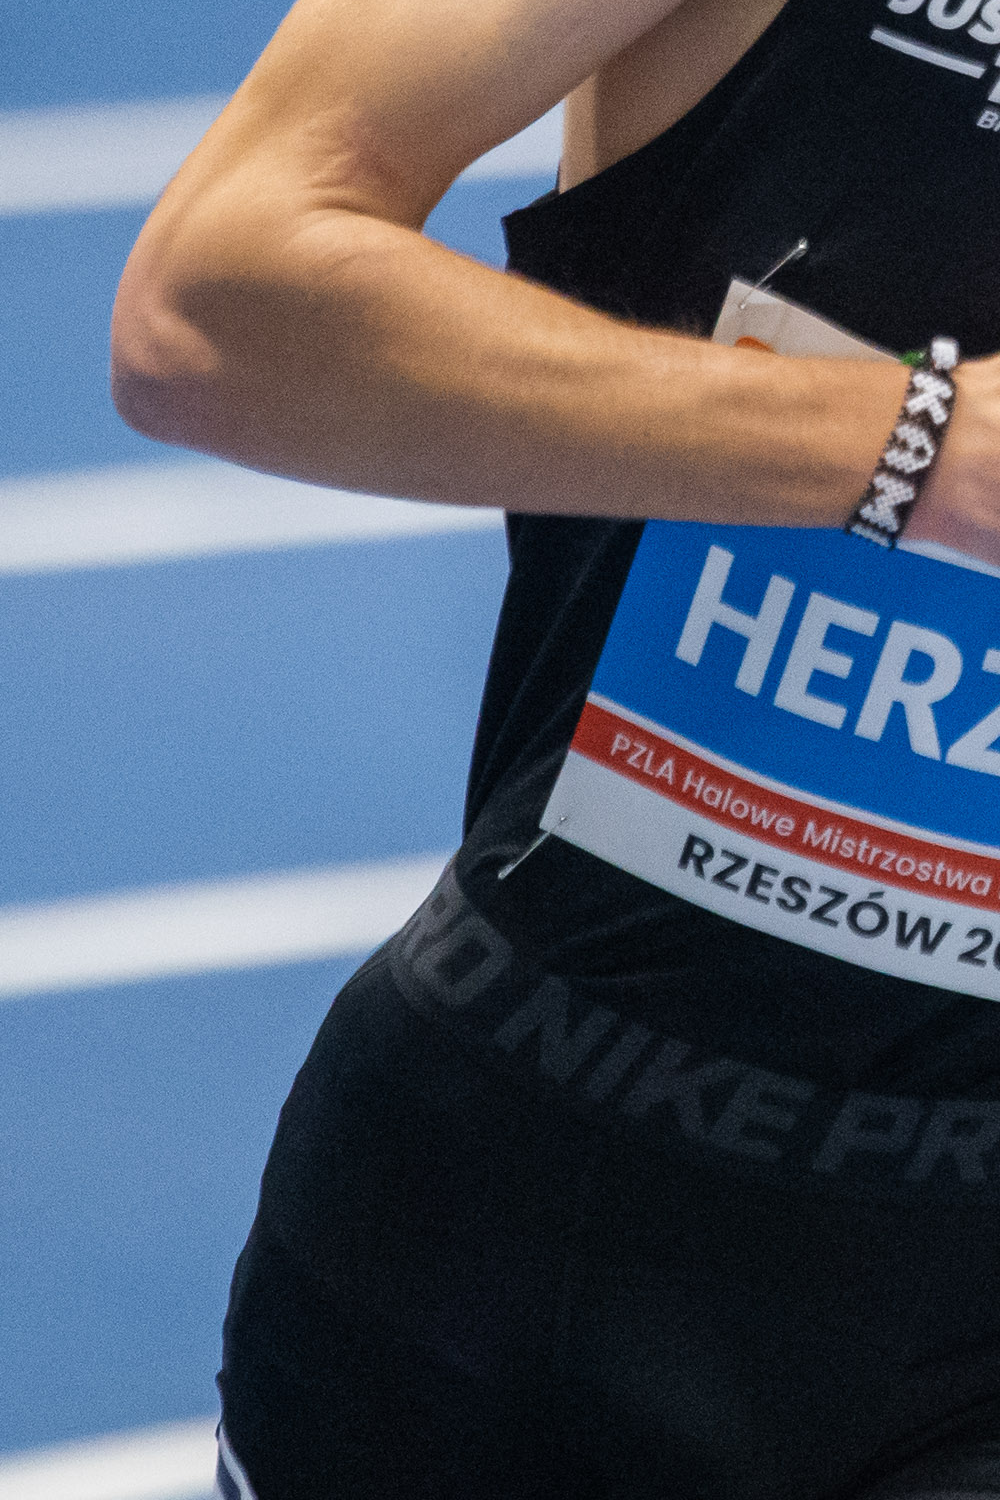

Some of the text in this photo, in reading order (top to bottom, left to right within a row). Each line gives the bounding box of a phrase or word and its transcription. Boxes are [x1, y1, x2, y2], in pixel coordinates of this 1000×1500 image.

[610, 733, 677, 786] PZLA
[681, 769, 796, 838] Halowe
[801, 820, 992, 897] Mistrzostwa
[677, 833, 952, 956] RZESZÓW
[492, 974, 815, 1161] NIKE
